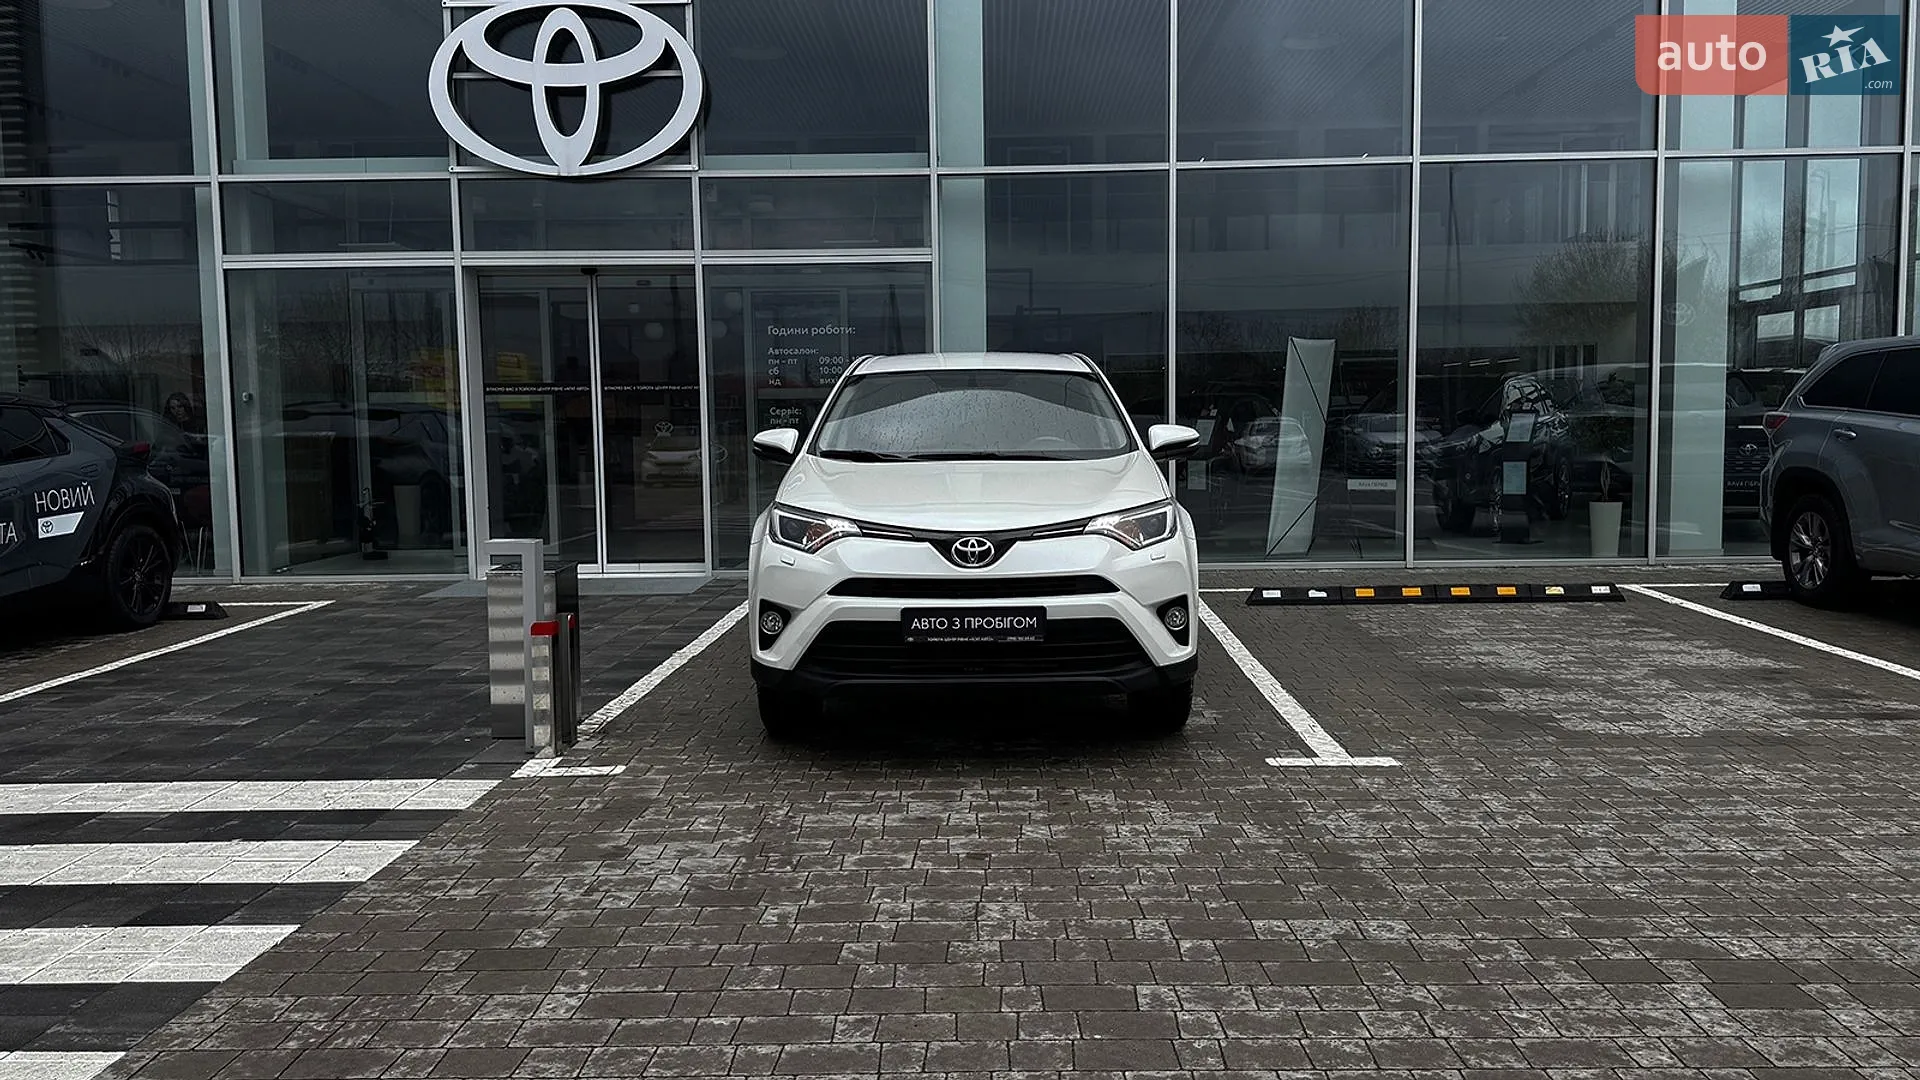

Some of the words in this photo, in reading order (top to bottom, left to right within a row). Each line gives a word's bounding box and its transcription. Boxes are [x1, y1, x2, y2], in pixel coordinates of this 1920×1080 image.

[767, 325, 809, 336] Години
[811, 324, 856, 336] роботи:
[767, 347, 819, 355] Автосалон:
[819, 356, 844, 364] 09:00
[768, 366, 780, 375] сб
[819, 366, 843, 374] 10:00
[769, 407, 802, 417] Сервіс:
[34, 481, 95, 513] НОВИЙ
[911, 617, 948, 629] АВТО
[965, 616, 1037, 629] ПРОБІГОМ
